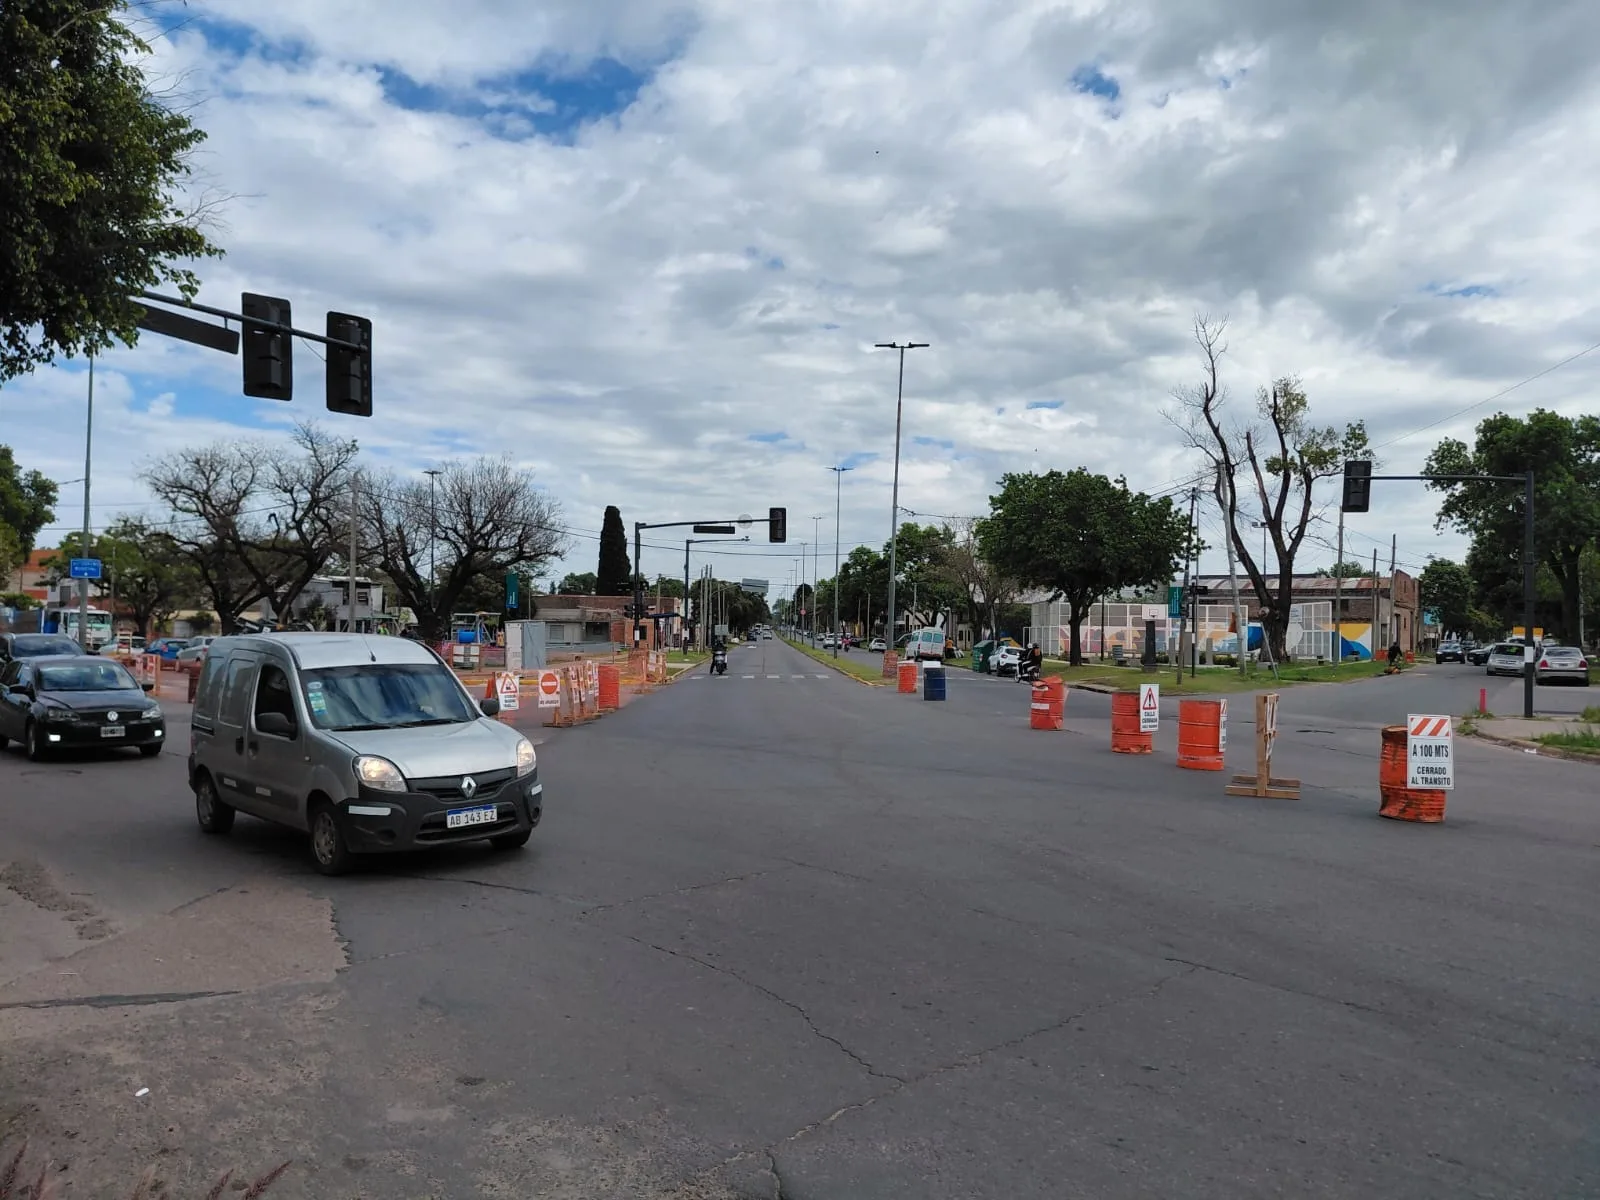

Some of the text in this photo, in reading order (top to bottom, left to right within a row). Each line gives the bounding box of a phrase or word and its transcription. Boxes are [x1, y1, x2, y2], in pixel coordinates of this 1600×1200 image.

[1412, 744, 1449, 758] A 100 MTS
[1416, 766, 1447, 775] CERRADO
[1411, 776, 1451, 786] AL TRANSITO
[450, 810, 495, 826] AB 143 EZ
